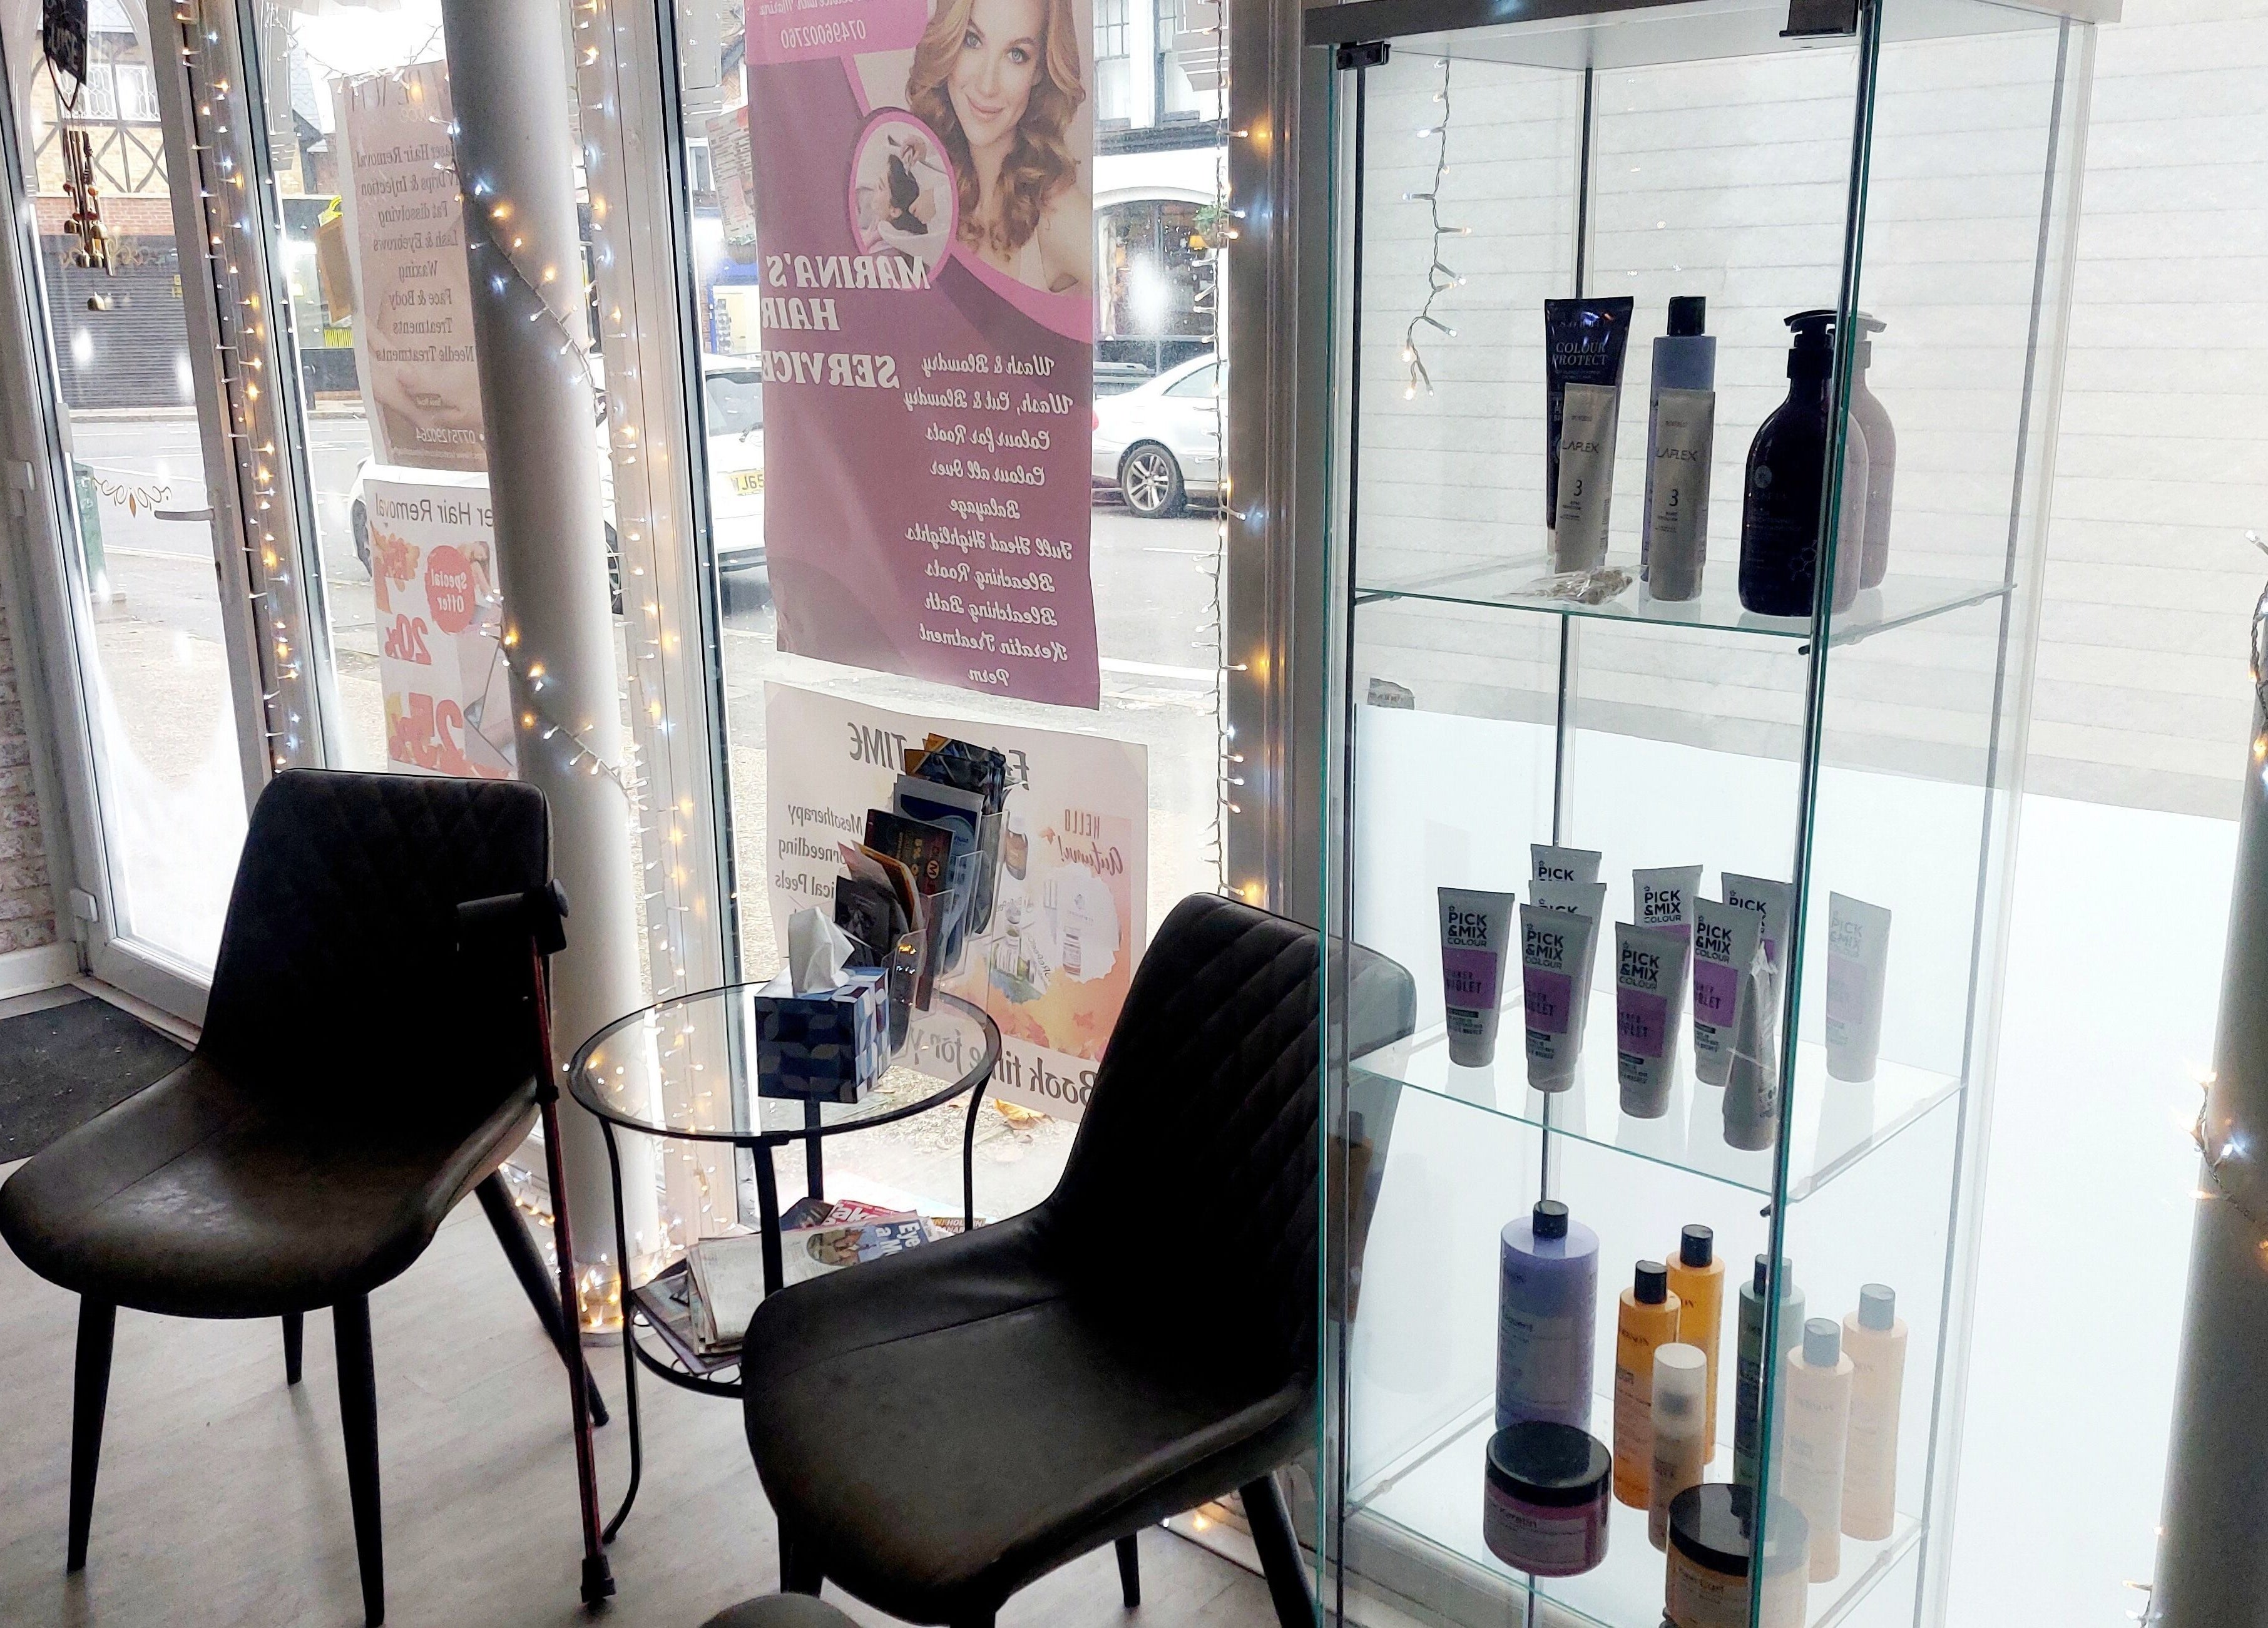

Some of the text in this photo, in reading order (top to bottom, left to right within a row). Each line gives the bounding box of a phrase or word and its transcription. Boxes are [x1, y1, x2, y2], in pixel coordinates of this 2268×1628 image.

[1556, 342, 1606, 354] COLOUR
[1551, 354, 1608, 366] PROTECT
[1573, 479, 1582, 497] 3
[1669, 488, 1678, 506] 3
[1538, 866, 1575, 881] PICK
[1644, 889, 1681, 904] PICK
[1448, 911, 1488, 928] PICK
[1643, 914, 1682, 924] COLOUR
[1526, 930, 1565, 949] PICK
[1697, 922, 1733, 942] PICK
[1447, 938, 1488, 948] COLOUR
[1525, 956, 1563, 970] COLOUR
[1622, 948, 1660, 970] PICK
[1695, 947, 1730, 964] COLOUR
[896, 1221, 921, 1248] Eye
